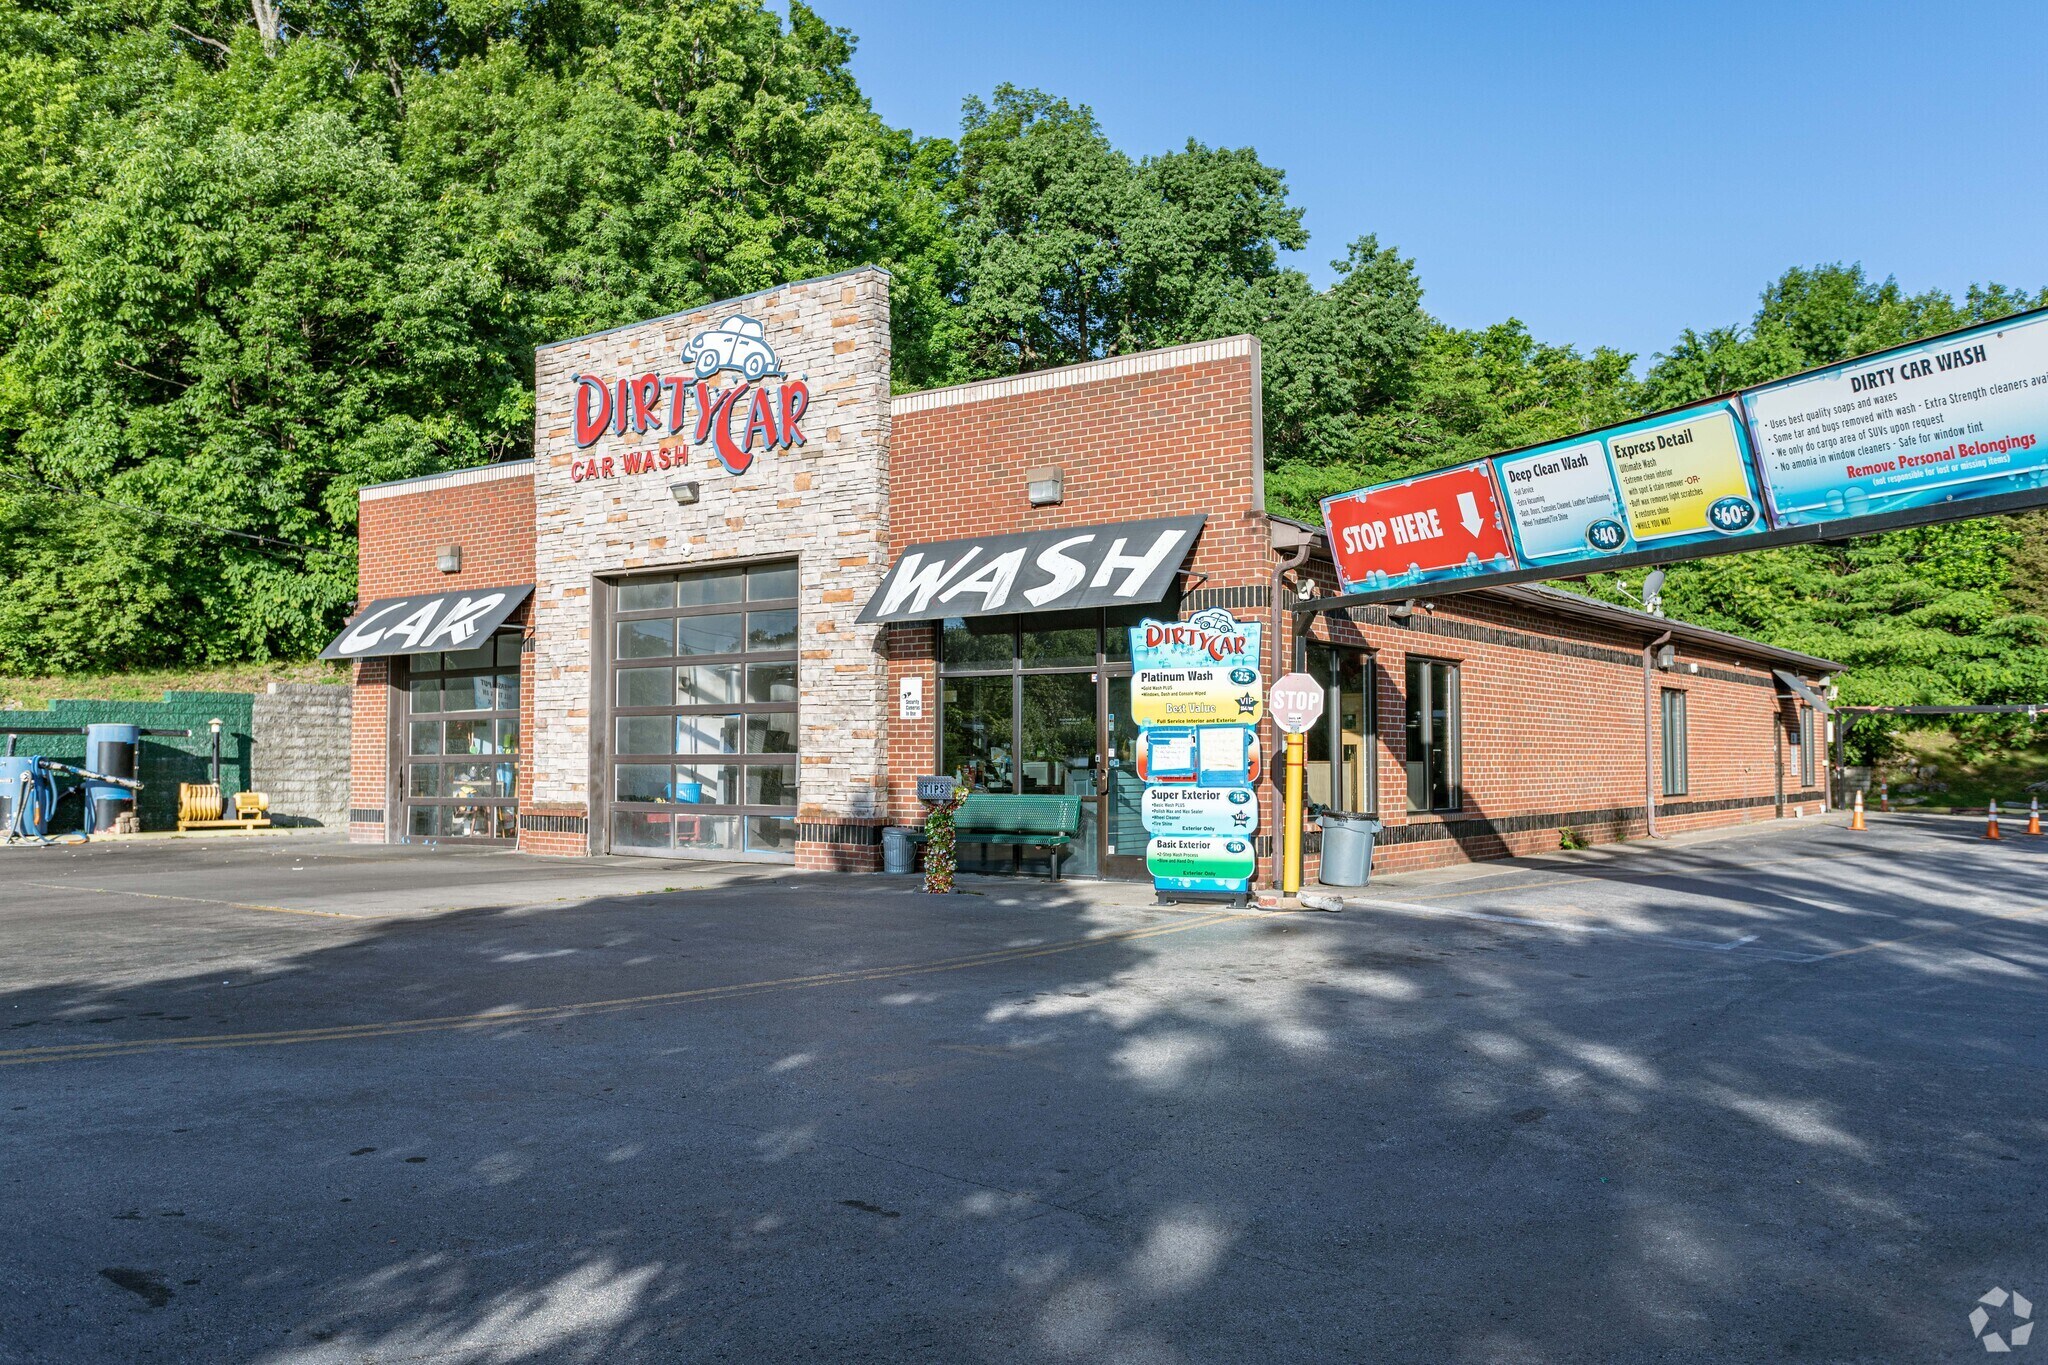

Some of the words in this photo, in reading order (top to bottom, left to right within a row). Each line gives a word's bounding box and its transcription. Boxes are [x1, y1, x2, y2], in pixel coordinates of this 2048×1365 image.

[1850, 367, 1895, 394] DIRTY
[1900, 359, 1934, 380] CAR
[1935, 344, 1987, 371] WASH
[1770, 418, 1788, 430] Uses
[1788, 412, 1805, 425] best
[1806, 407, 1832, 421] quality
[1833, 402, 1856, 416] soaps
[1857, 396, 1872, 409] and
[1873, 392, 1898, 405] waxes
[1773, 432, 1793, 444] Some
[1793, 428, 1805, 439] tar
[1807, 424, 1820, 436] and
[1822, 420, 1840, 433] bugs
[1841, 410, 1874, 429] removed
[1876, 407, 1894, 421] with
[1895, 402, 1917, 416] wash
[1924, 396, 1948, 411] Extra
[1949, 386, 1988, 405] Strength
[1989, 377, 2029, 396] cleaners
[573, 373, 732, 449] DIRTY
[713, 380, 810, 475] CAR
[1613, 440, 1656, 460] Express
[1657, 428, 1694, 451] Detail
[1776, 447, 1787, 458] We
[1788, 443, 1804, 456] only
[1805, 440, 1815, 451] do
[1816, 436, 1838, 450] cargo
[1839, 433, 1857, 444] area
[1858, 429, 1867, 441] of
[1867, 424, 1889, 439] SUVs
[1890, 420, 1911, 435] upon
[1912, 413, 1944, 430] request
[1780, 461, 1790, 472] No
[1792, 455, 1818, 470] amonia
[1819, 452, 1827, 463] in
[1828, 448, 1856, 462] window
[1857, 440, 1892, 456] cleaners
[1898, 436, 1917, 448] Safe
[1918, 432, 1931, 444] for
[1933, 426, 1966, 441] window
[1967, 421, 1984, 434] tint
[571, 456, 615, 482] CAR
[623, 445, 689, 476] WASH
[1619, 460, 1642, 474] Ultimate
[1643, 458, 1657, 469] Wash
[1846, 459, 1896, 478] Remove
[1898, 446, 1956, 469] Personal
[1958, 434, 2037, 457] Belongings
[1508, 470, 1532, 483] Deep
[1533, 461, 1561, 477] Clean
[1560, 453, 1589, 471] Wash
[1643, 472, 1656, 481] clean
[1656, 468, 1673, 479] interior
[1887, 470, 1924, 484] responsible
[1925, 468, 1935, 477] for
[1936, 465, 1950, 475] lost
[1960, 460, 1987, 473] missing
[1628, 487, 1638, 496] with
[1638, 485, 1649, 495] spot
[1653, 482, 1665, 492] stain
[1665, 479, 1684, 489] remover
[1650, 494, 1668, 504] removes
[1668, 490, 1681, 502] light
[1680, 487, 1704, 499] scratches
[1638, 508, 1657, 518] restores
[1657, 505, 1669, 515] shine
[1714, 505, 1742, 525] $60
[1342, 520, 1387, 555] STOP
[1389, 508, 1443, 546] HERE
[1593, 526, 1617, 544] $40
[876, 529, 1187, 617] WASH
[339, 593, 505, 654] CAR
[1146, 625, 1214, 650] DIRTY
[1208, 635, 1246, 661] CAR
[1141, 672, 1185, 682] Platinum
[1187, 671, 1213, 681] Wash
[1234, 671, 1250, 682] $25
[1166, 703, 1187, 713] Best
[1188, 703, 1216, 713] Value
[1240, 697, 1254, 705] VIP
[1274, 690, 1319, 711] STOP
[923, 785, 945, 794] TIPS
[1151, 790, 1179, 801] Super
[1182, 790, 1220, 800] Exterior
[1157, 840, 1177, 849] Basic
[1179, 840, 1211, 850] Exterior
